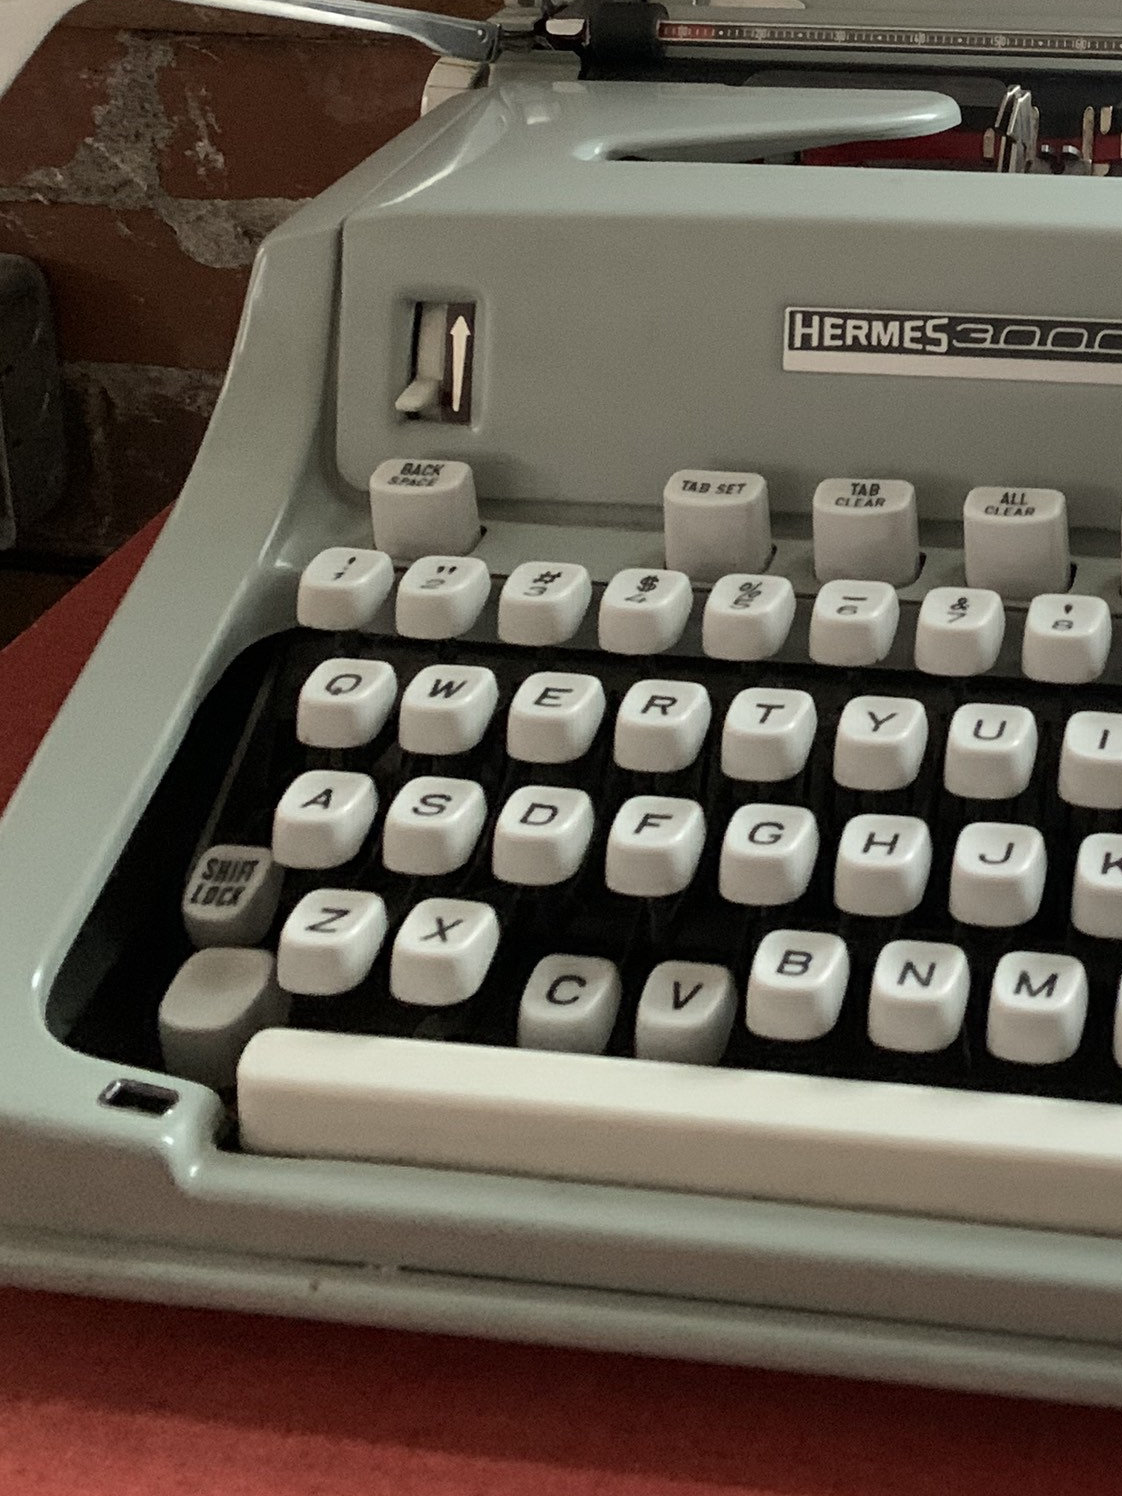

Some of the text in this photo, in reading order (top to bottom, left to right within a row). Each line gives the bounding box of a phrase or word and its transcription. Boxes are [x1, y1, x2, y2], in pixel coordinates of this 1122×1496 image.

[793, 312, 948, 353] HERMES
[400, 463, 444, 476] BACK
[681, 480, 747, 495] TAB SET
[850, 482, 880, 496] TAB
[834, 497, 886, 507] CLEAR
[1000, 492, 1028, 505] ALL
[984, 505, 1035, 517] CLEAR
[420, 579, 445, 589] 2
[533, 571, 562, 584] #
[637, 575, 659, 592] $
[625, 594, 646, 603] 4
[739, 581, 762, 598] %
[950, 597, 969, 610] &
[325, 673, 362, 696] Q
[428, 679, 468, 698] W
[534, 687, 573, 707] E
[640, 695, 678, 715] R
[755, 704, 785, 724] T
[868, 711, 898, 732] Y
[973, 719, 1007, 740] U
[1098, 730, 1110, 749] I
[301, 788, 334, 809] A
[412, 794, 452, 816] S
[520, 803, 558, 825] D
[634, 813, 673, 834] F
[748, 822, 785, 845] G
[861, 832, 900, 855] H
[978, 843, 1015, 865] J
[202, 858, 259, 882] SHIFT
[191, 884, 246, 906] LOCK
[305, 907, 350, 933] Z
[419, 916, 463, 943] X
[776, 950, 813, 976] B
[897, 961, 936, 987] N
[1013, 970, 1058, 997] M
[545, 974, 586, 1005] C
[672, 981, 703, 1010] V
